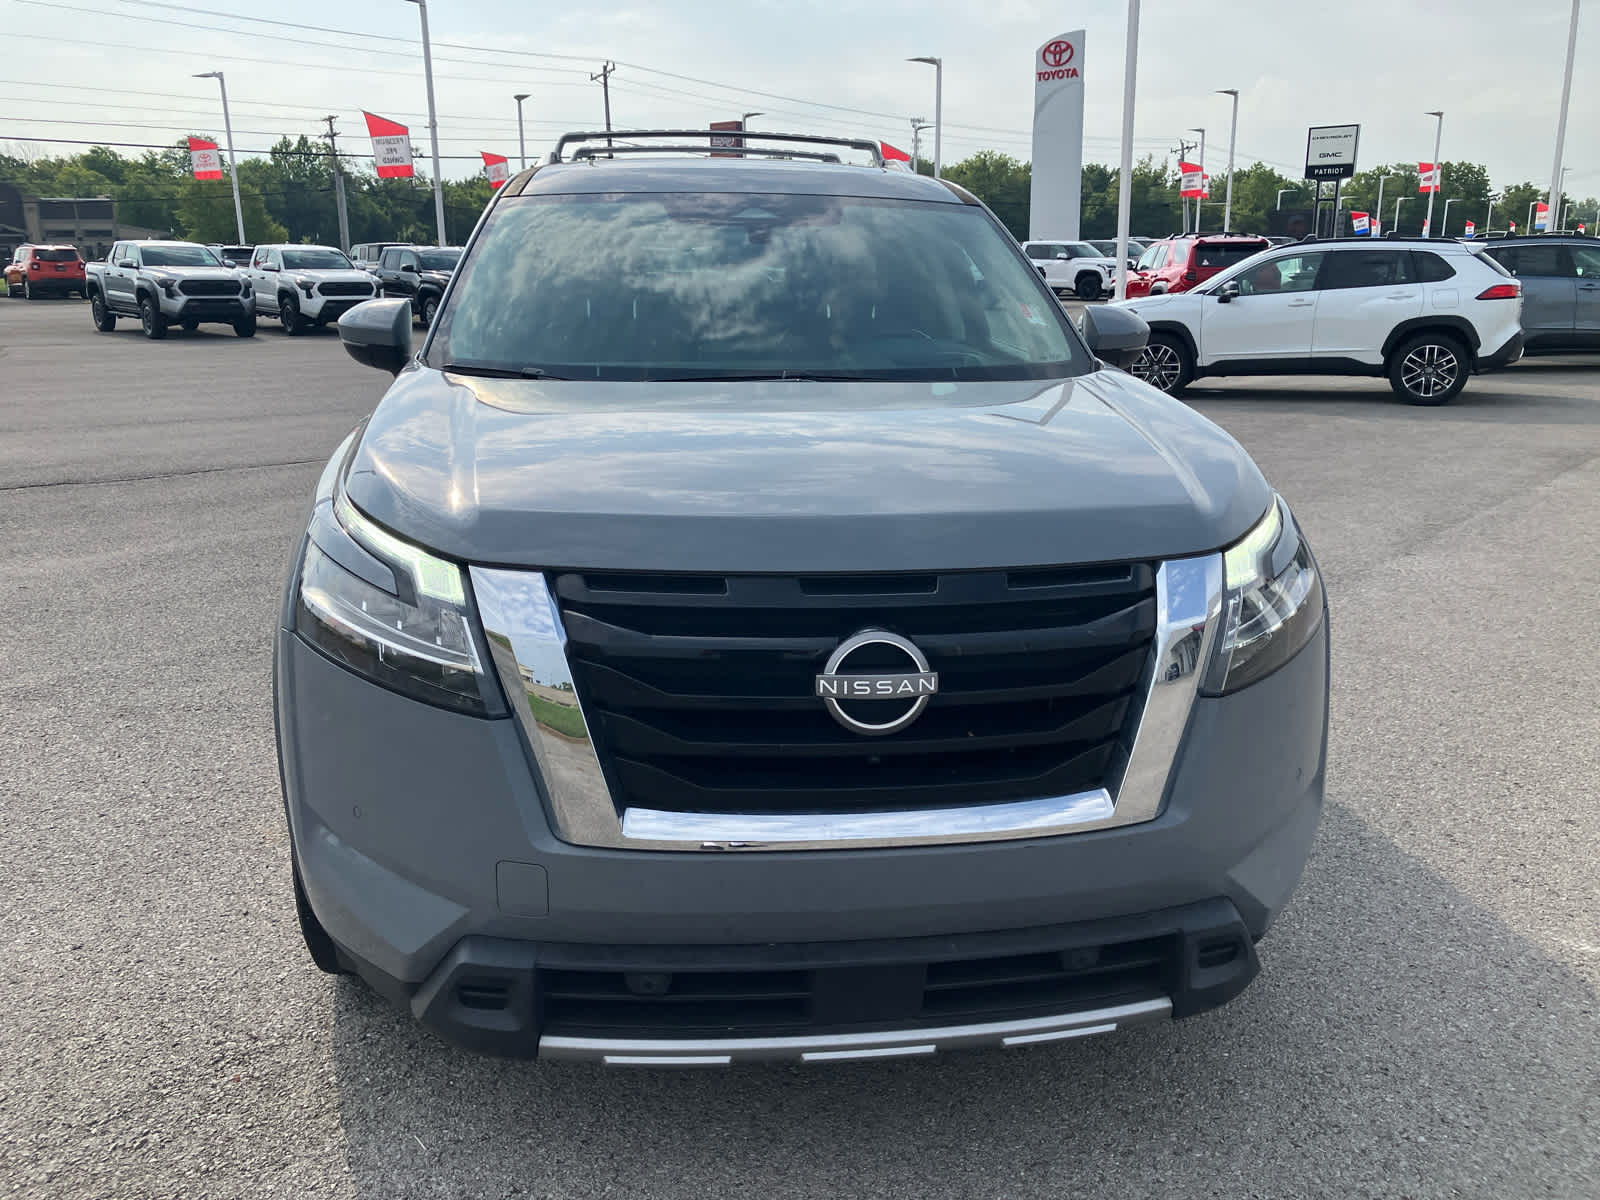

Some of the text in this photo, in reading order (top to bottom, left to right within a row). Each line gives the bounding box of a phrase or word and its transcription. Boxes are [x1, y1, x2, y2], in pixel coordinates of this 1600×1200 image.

[1036, 68, 1079, 82] TOYOTA
[1314, 167, 1344, 175] PATRIOT
[819, 677, 935, 694] NISSAN
